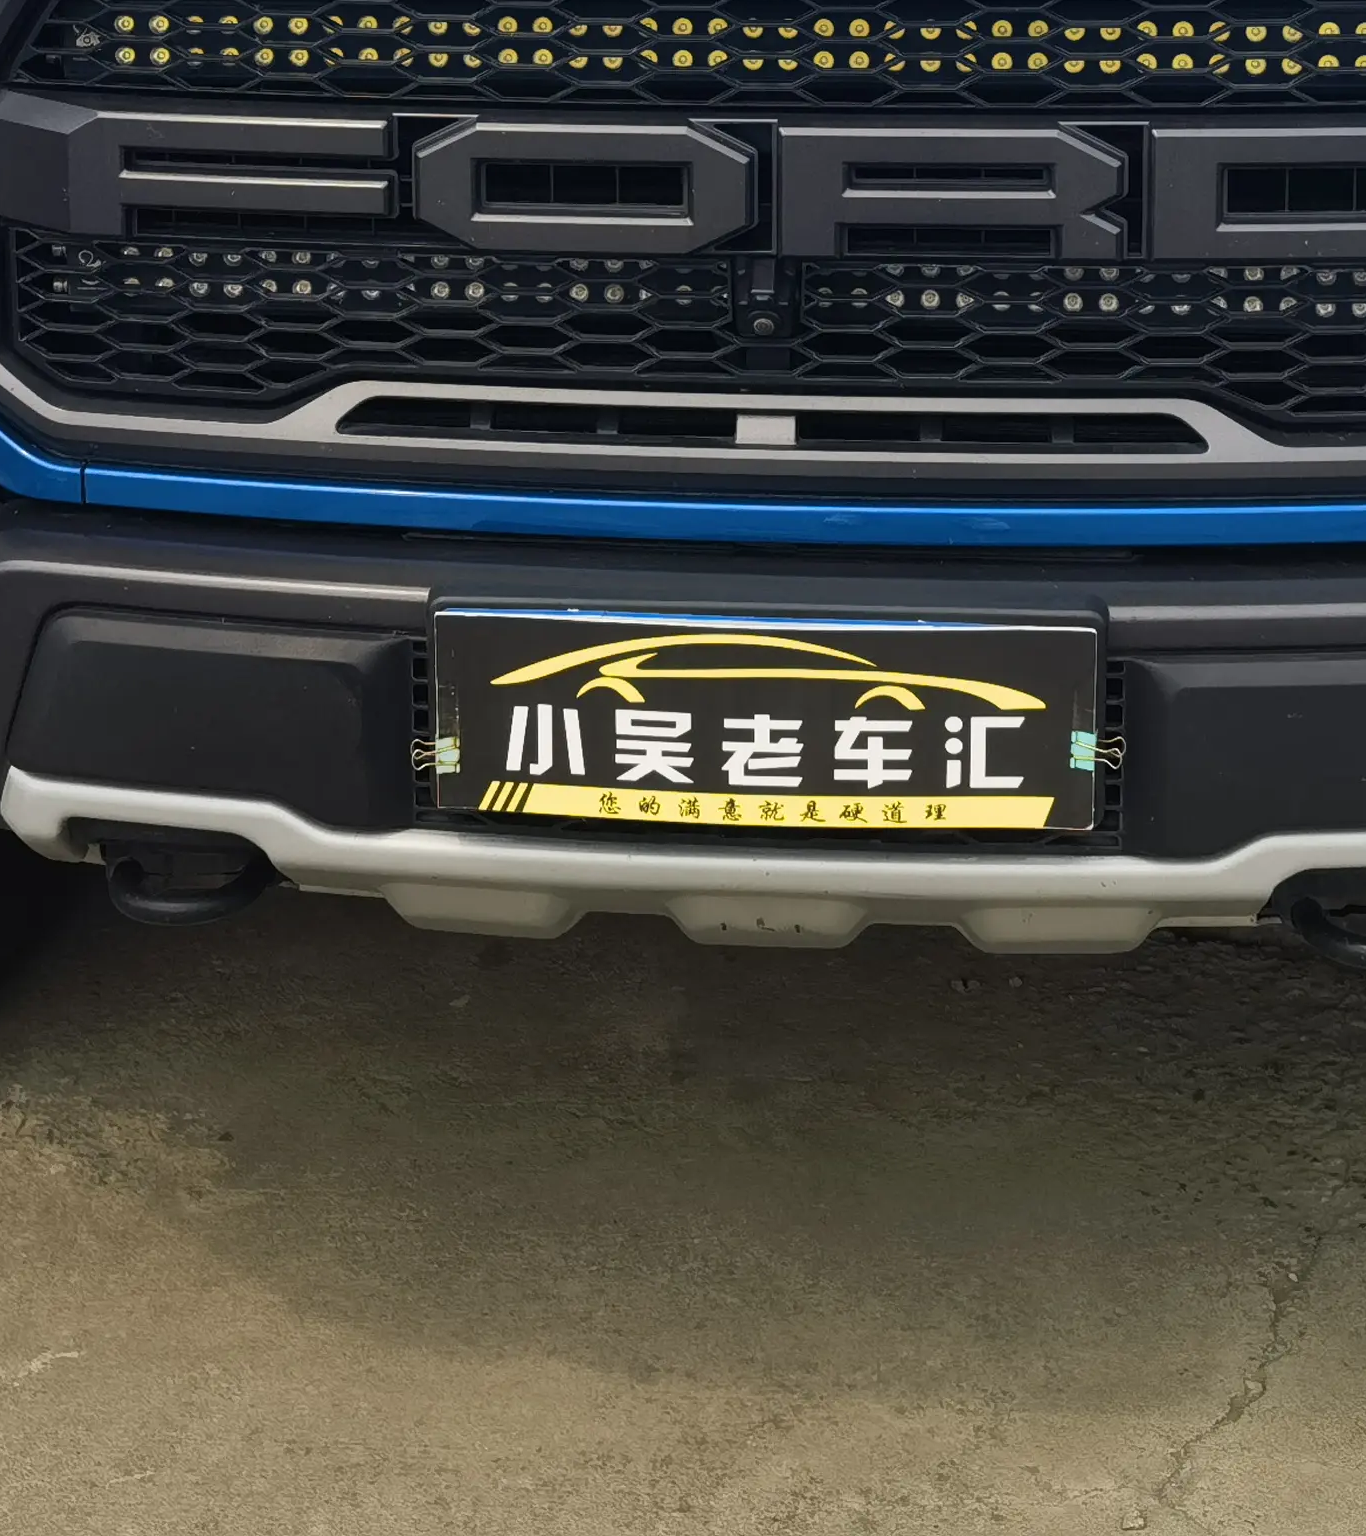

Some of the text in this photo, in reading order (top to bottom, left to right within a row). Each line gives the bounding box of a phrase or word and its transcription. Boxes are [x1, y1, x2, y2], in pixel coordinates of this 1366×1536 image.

[505, 704, 1026, 790] 小吴老车汇
[598, 791, 948, 824] 您的满意就是硬道理
